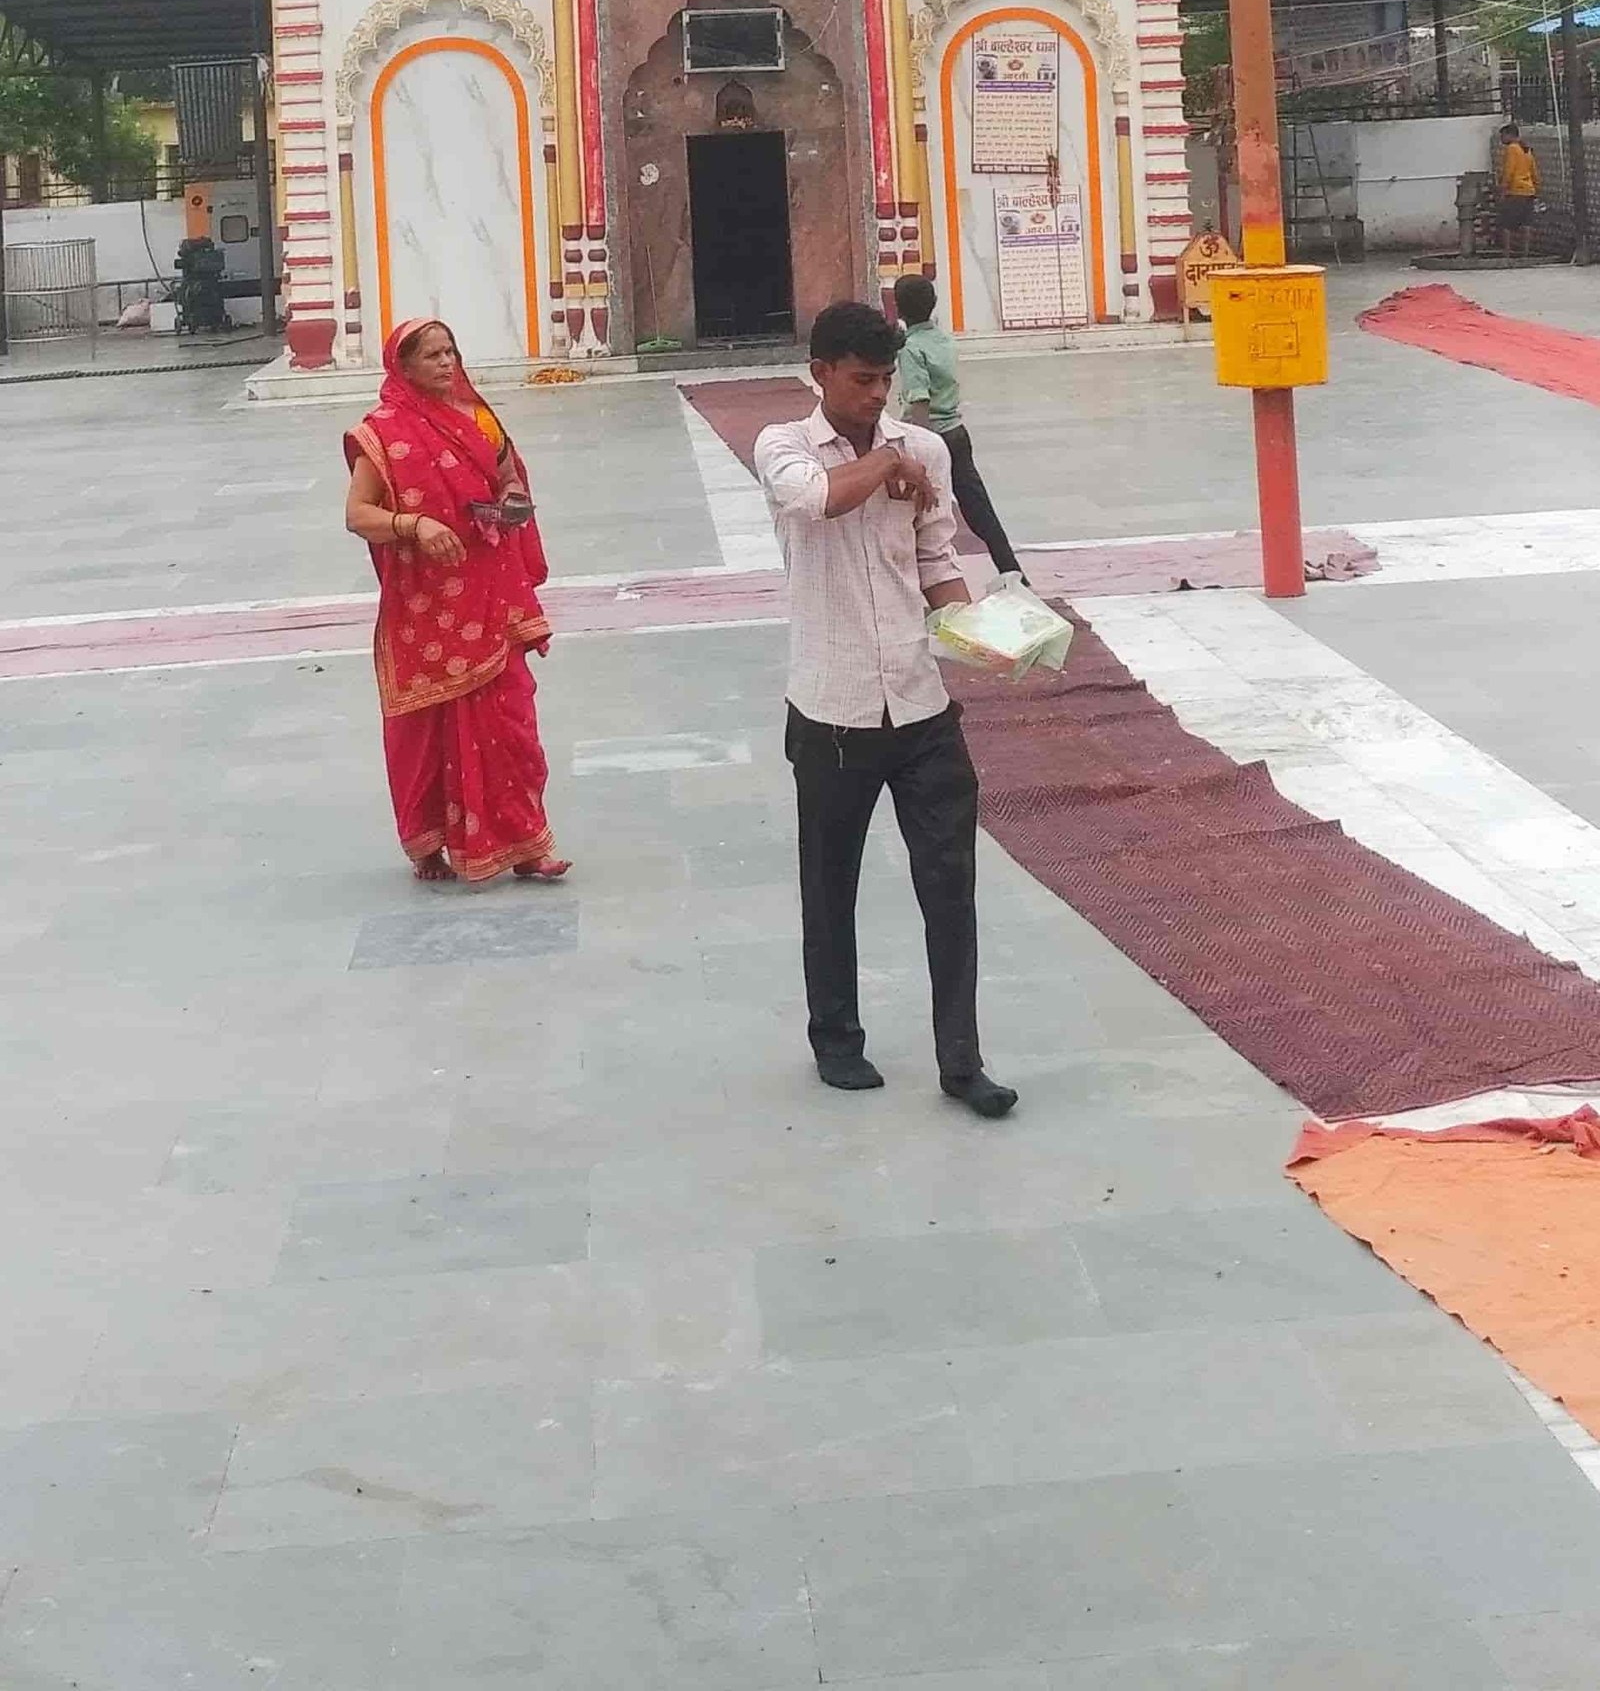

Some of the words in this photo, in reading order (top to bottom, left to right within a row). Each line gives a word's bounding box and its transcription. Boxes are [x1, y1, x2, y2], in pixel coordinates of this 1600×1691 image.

[976, 38, 987, 52] श्री
[1036, 40, 1056, 53] धाम
[1012, 193, 1052, 208] बाल्हेश्व
